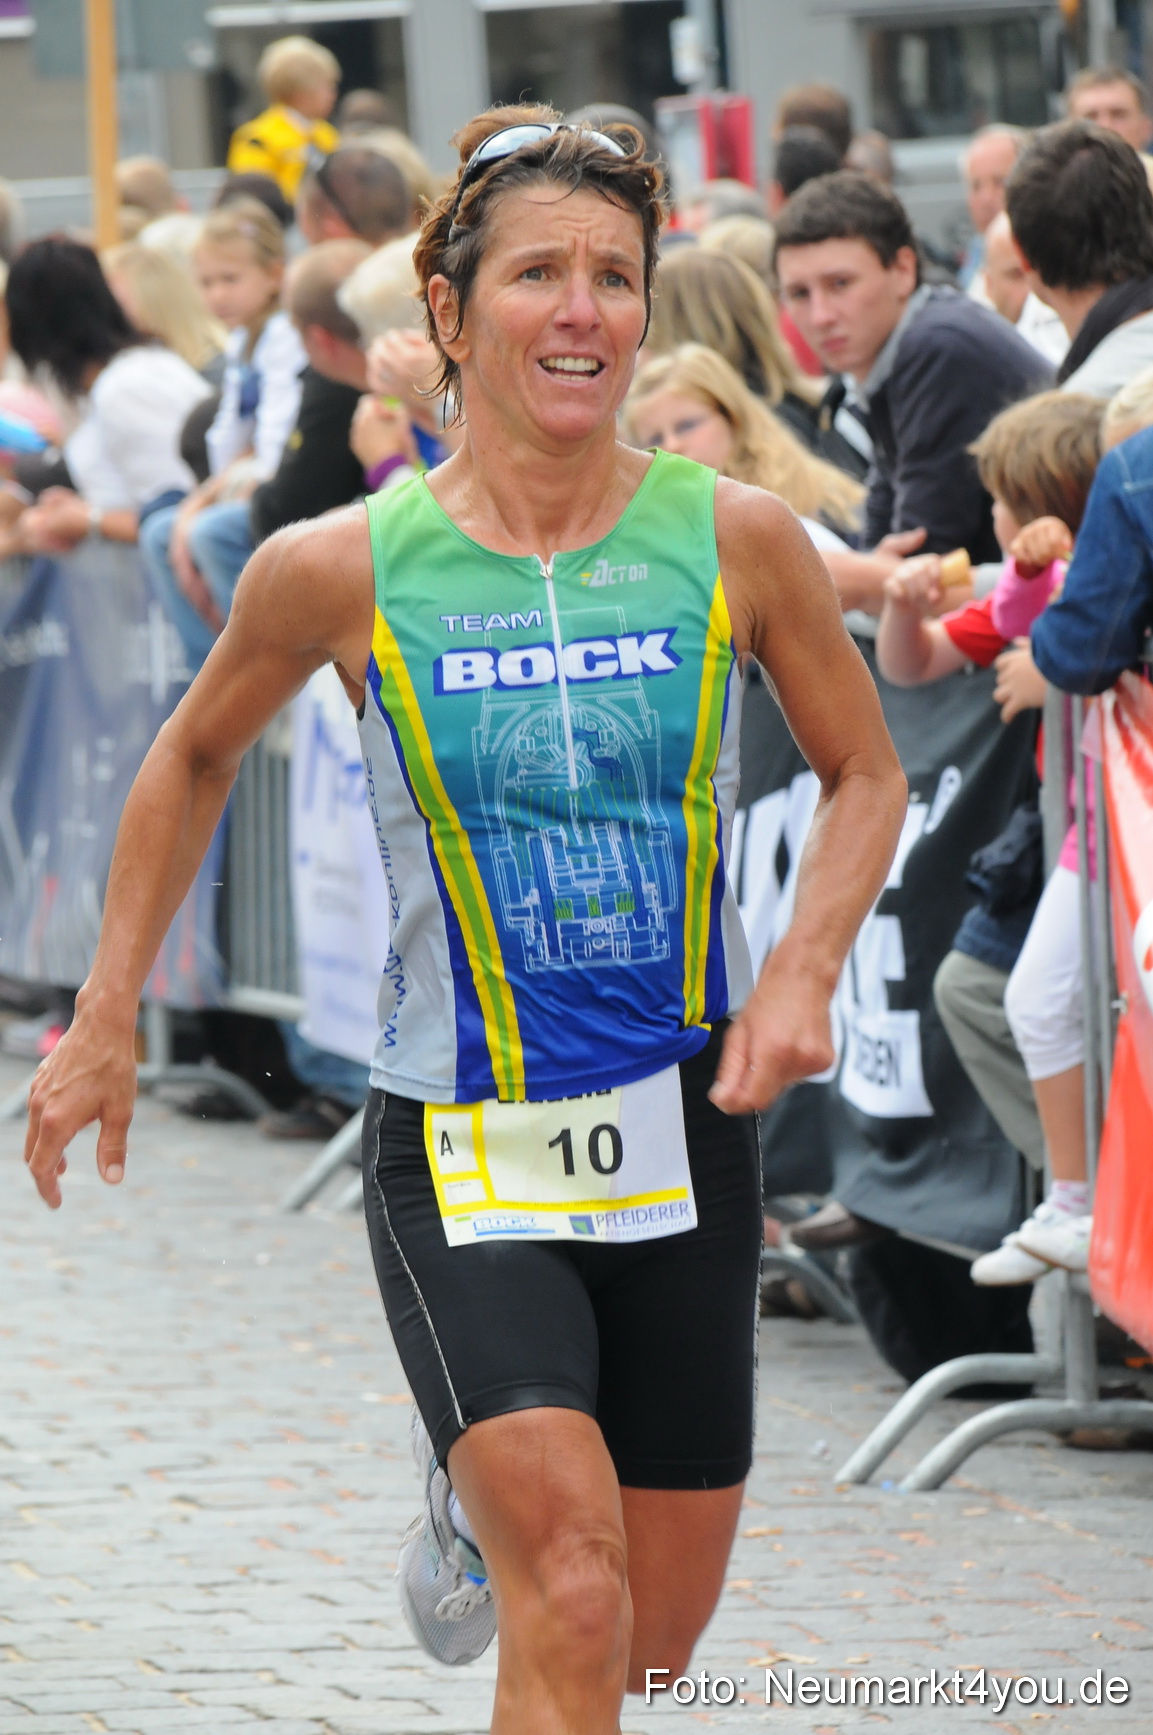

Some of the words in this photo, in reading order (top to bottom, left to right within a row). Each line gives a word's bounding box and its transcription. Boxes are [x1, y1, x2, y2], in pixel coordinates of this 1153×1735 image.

[439, 608, 544, 633] TEAM
[433, 627, 683, 696] BOCK
[440, 1130, 454, 1156] A
[548, 1123, 624, 1176] 10
[595, 1201, 691, 1228] PFLEIDERER
